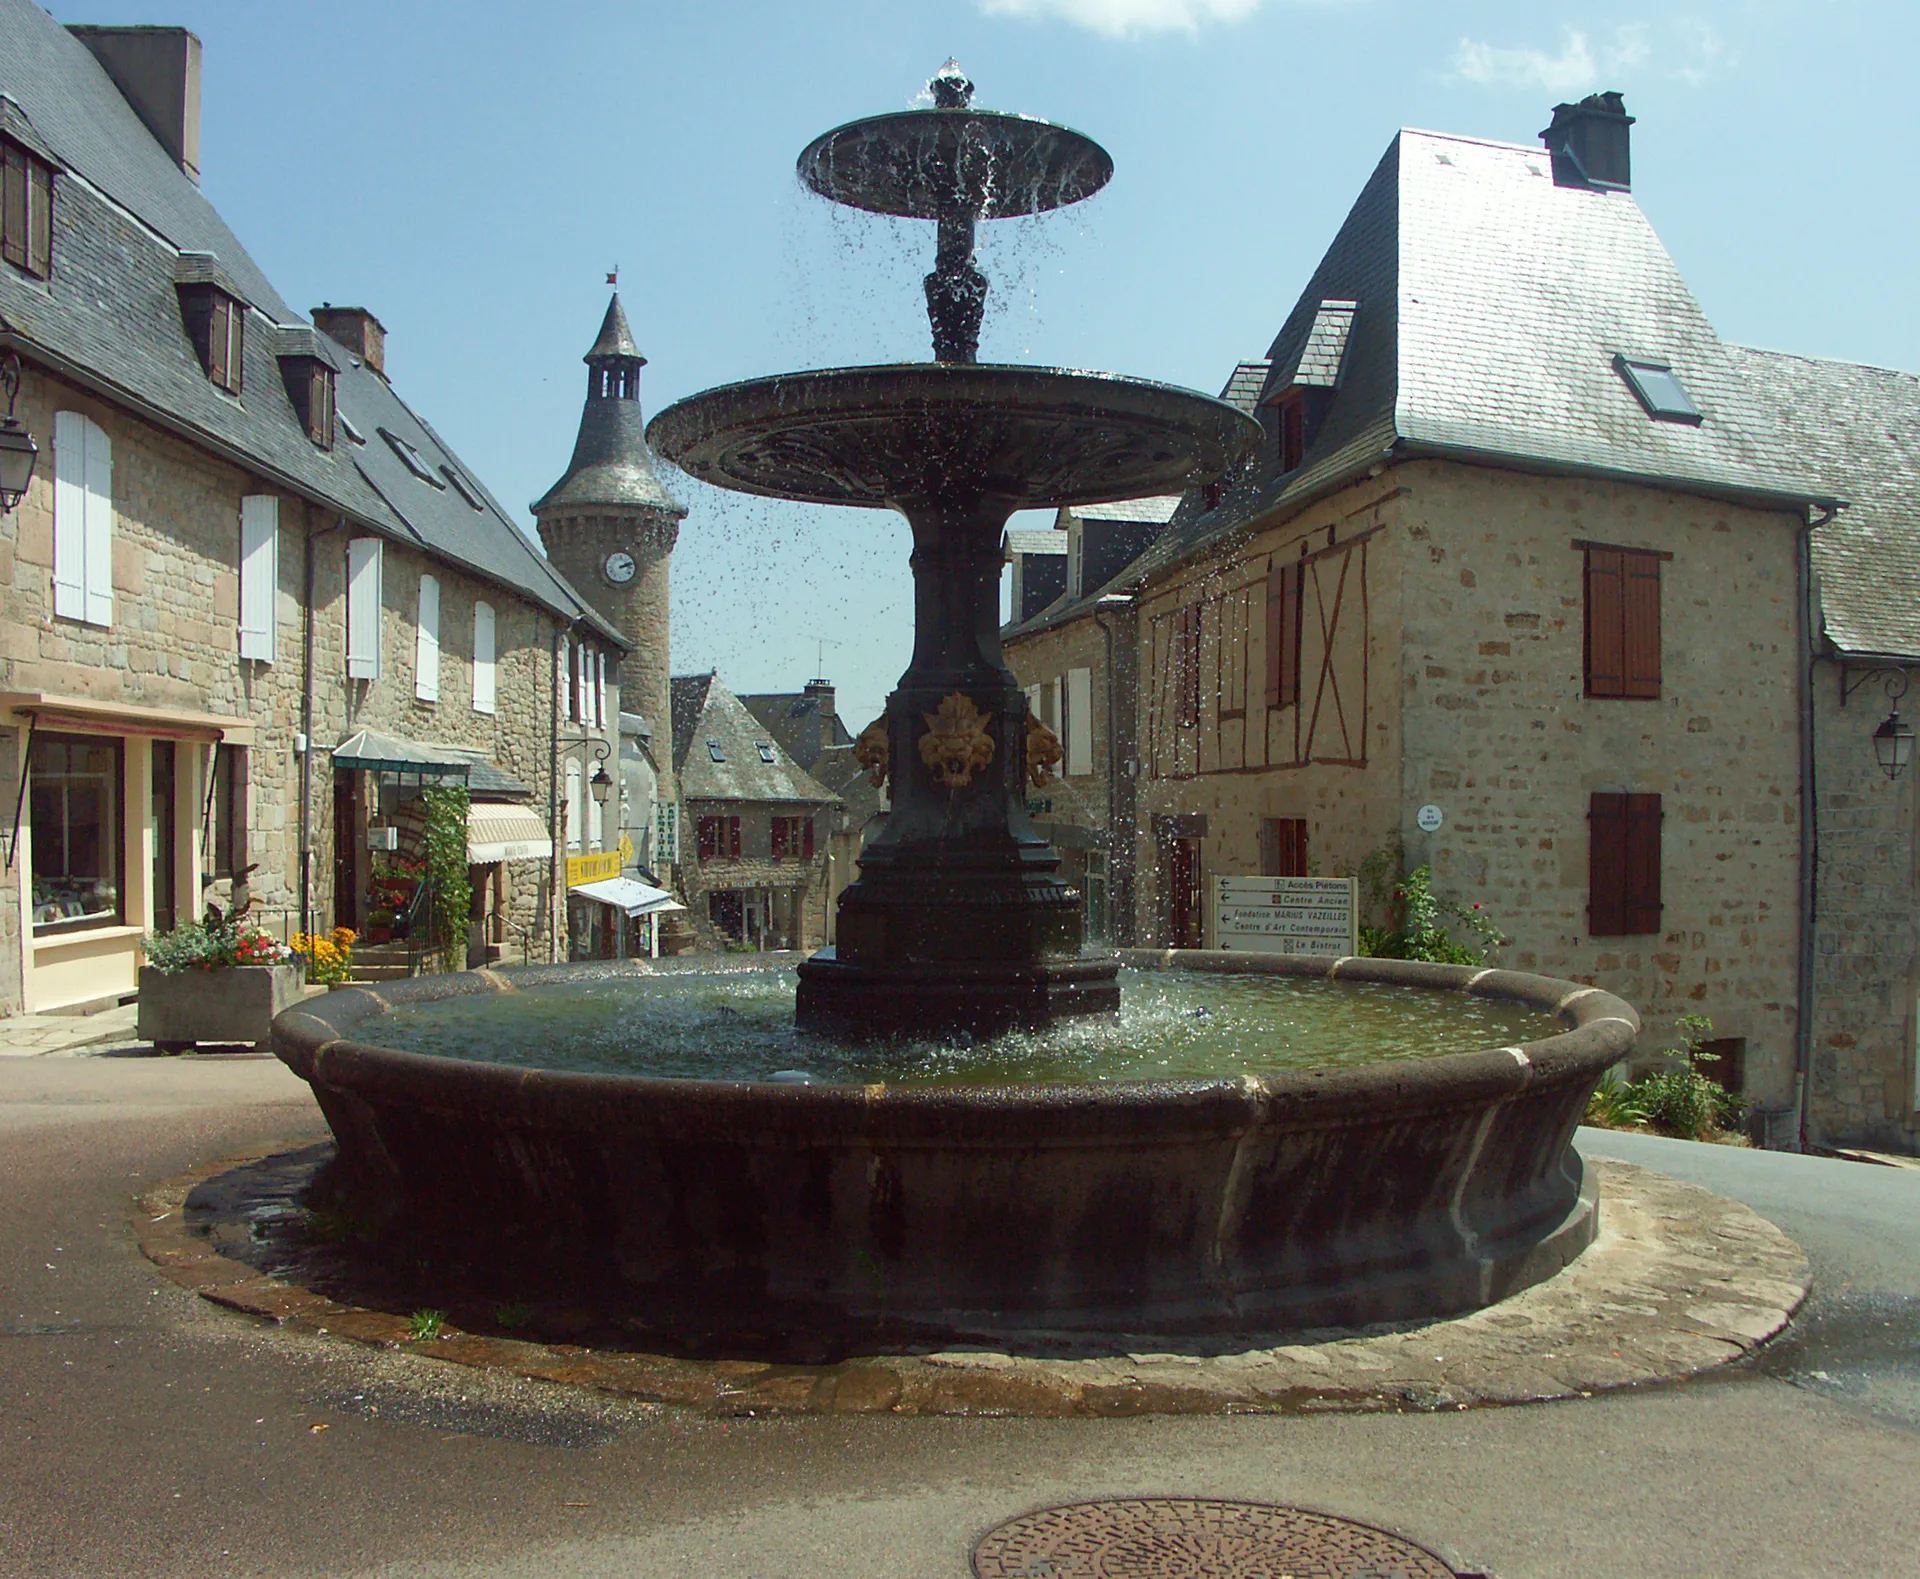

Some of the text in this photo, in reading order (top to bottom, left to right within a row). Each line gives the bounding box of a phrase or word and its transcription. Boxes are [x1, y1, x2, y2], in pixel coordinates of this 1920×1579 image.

[1284, 896, 1348, 904] Centre Ancien
[1274, 911, 1303, 919] MARIUS
[1308, 912, 1347, 920] VAZEILLES
[1234, 922, 1260, 930] Centre
[1290, 924, 1347, 934] Contemporain
